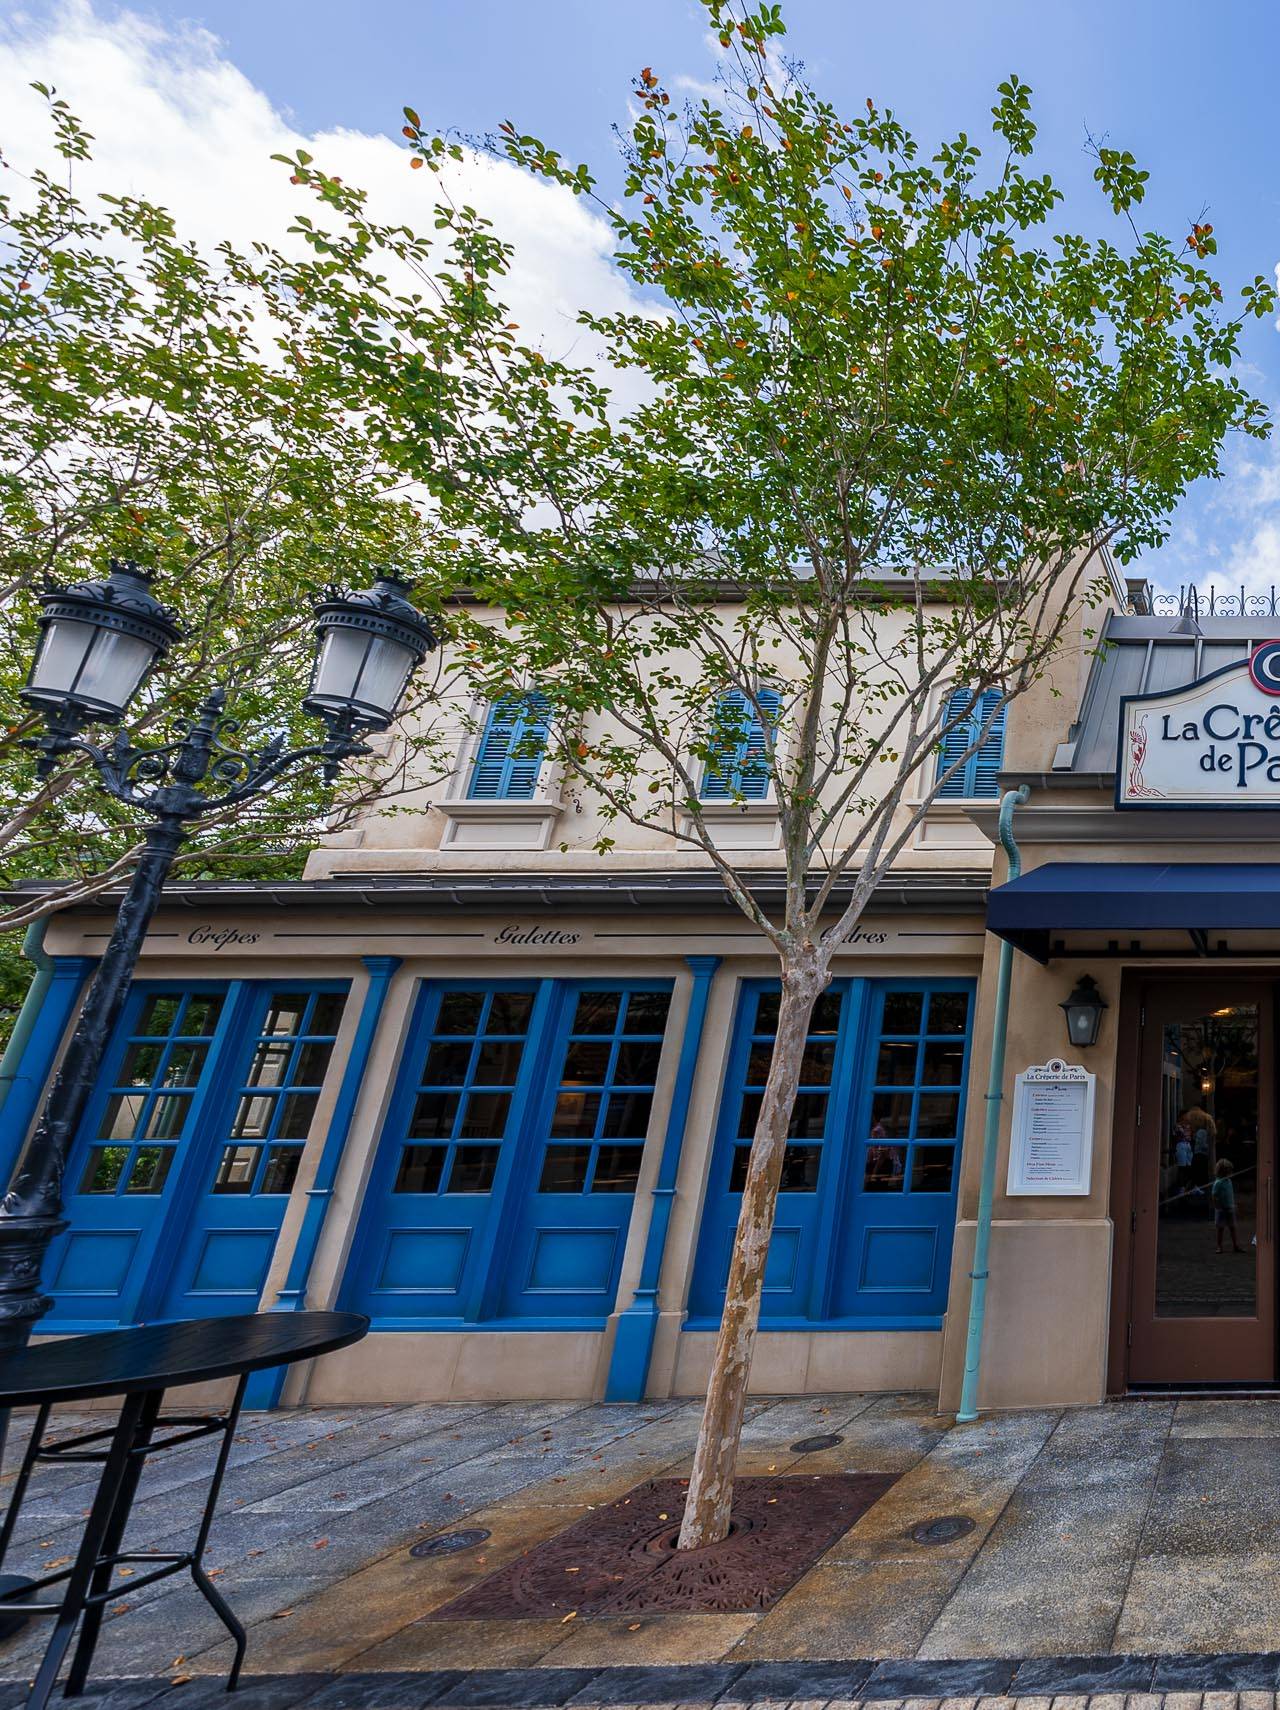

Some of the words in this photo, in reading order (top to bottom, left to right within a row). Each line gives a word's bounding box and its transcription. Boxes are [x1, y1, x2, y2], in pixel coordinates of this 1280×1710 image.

[1161, 714, 1200, 741] La
[1200, 745, 1233, 772] de
[187, 925, 261, 951] Crêpes
[494, 924, 581, 946] Galettes
[819, 924, 888, 944] Cdres
